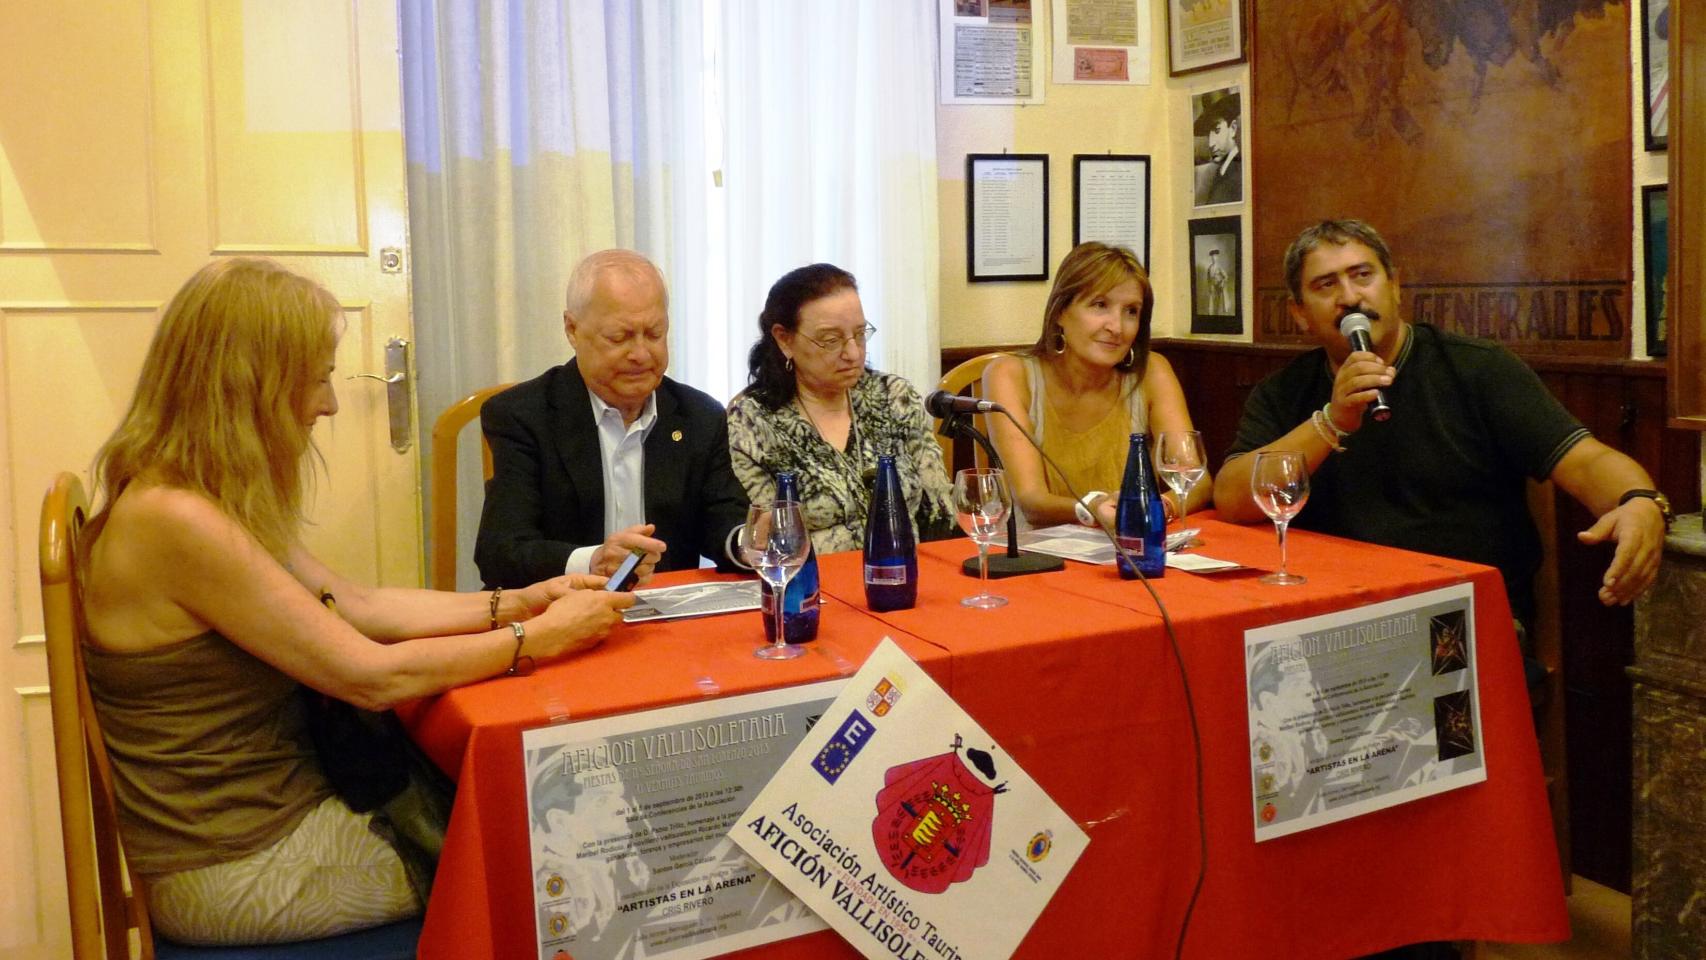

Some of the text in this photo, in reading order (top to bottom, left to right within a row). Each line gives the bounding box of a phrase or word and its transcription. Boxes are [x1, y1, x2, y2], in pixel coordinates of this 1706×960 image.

[1271, 614, 1418, 665] AFICION VALLISOLETANA
[562, 713, 787, 776] AFICION VALLISOLETANA
[844, 720, 867, 745] E
[1348, 757, 1359, 765] EN
[1361, 753, 1370, 761] LA
[747, 815, 833, 889] AFICIÓN
[782, 802, 862, 878] Asociación
[860, 873, 920, 930] Artístico
[662, 896, 714, 917] CRIS RIVERO
[680, 888, 695, 899] EN
[698, 884, 712, 895] LA
[841, 873, 878, 909] FUNDADA
[878, 906, 891, 918] EN
